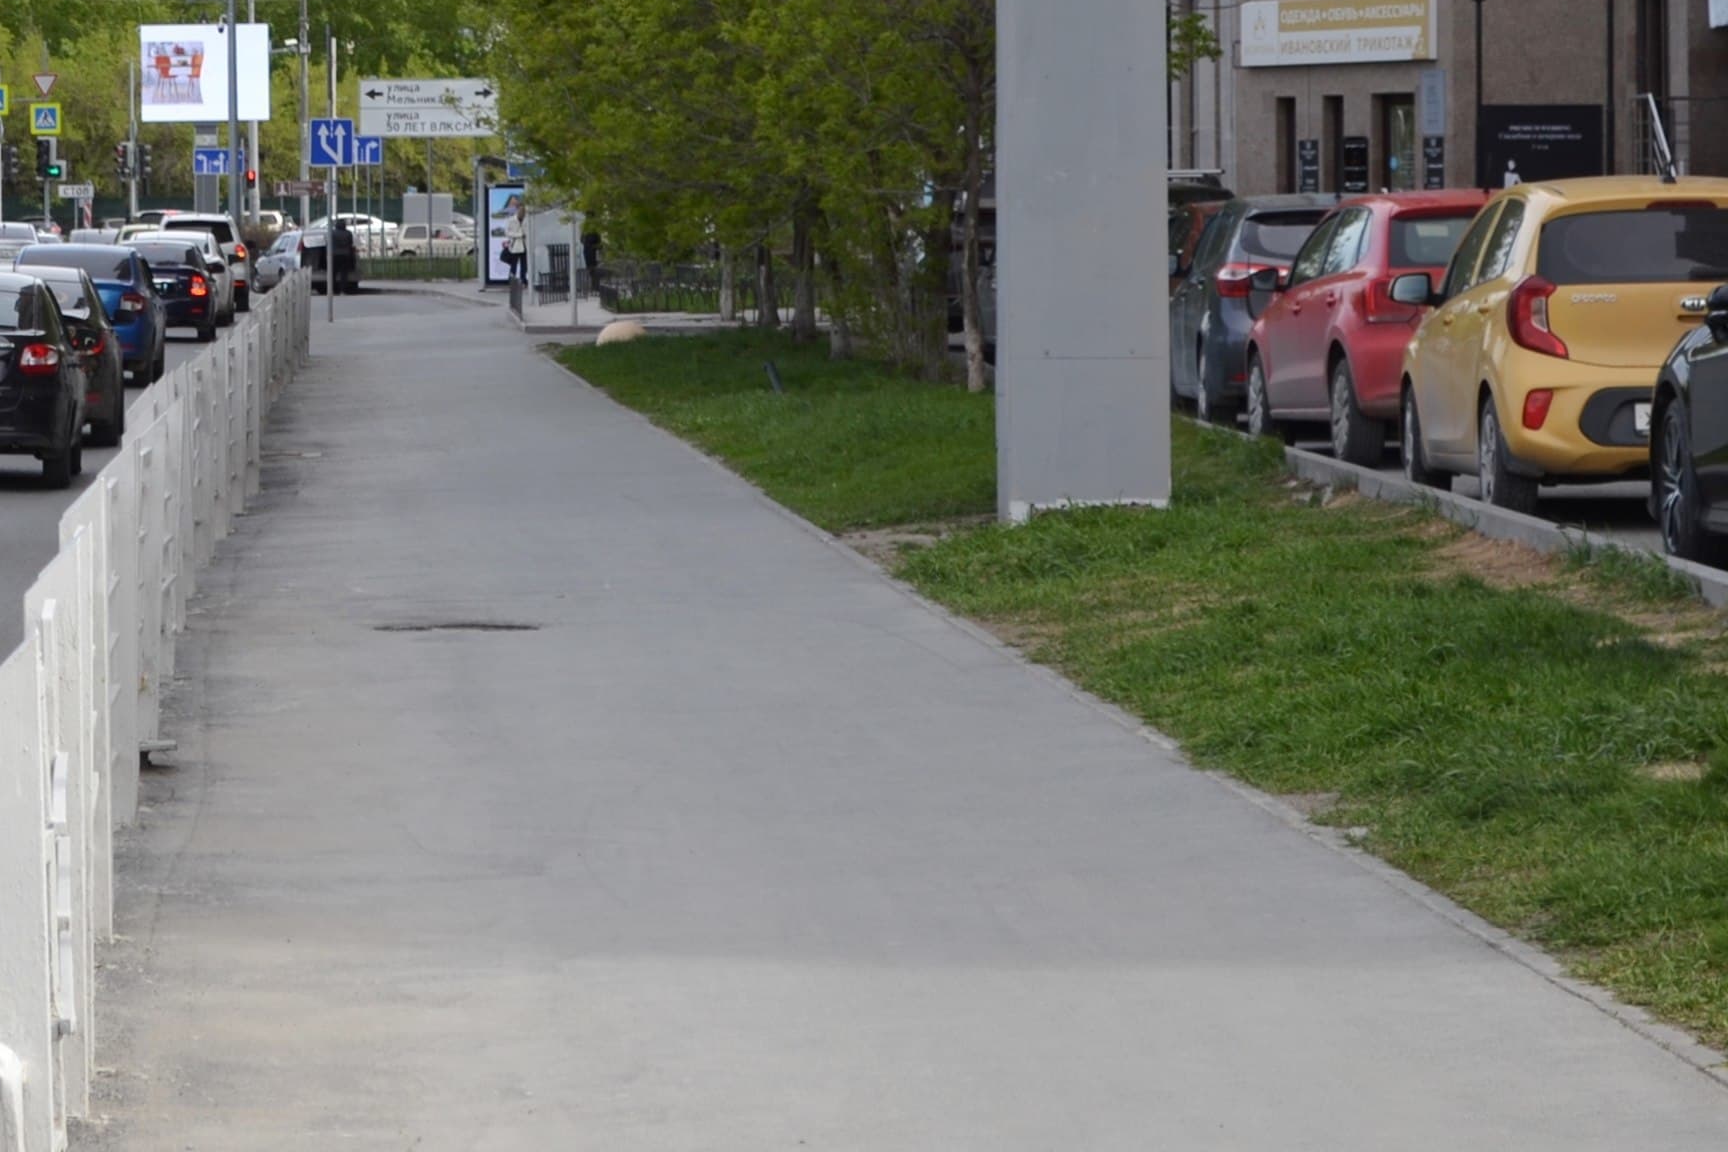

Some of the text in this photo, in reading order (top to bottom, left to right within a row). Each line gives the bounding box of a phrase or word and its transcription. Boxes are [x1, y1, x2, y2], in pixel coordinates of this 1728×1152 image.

[387, 84, 420, 94] улица
[386, 112, 420, 122] улица
[386, 121, 400, 133] 50
[404, 121, 427, 133] ЛЕТ
